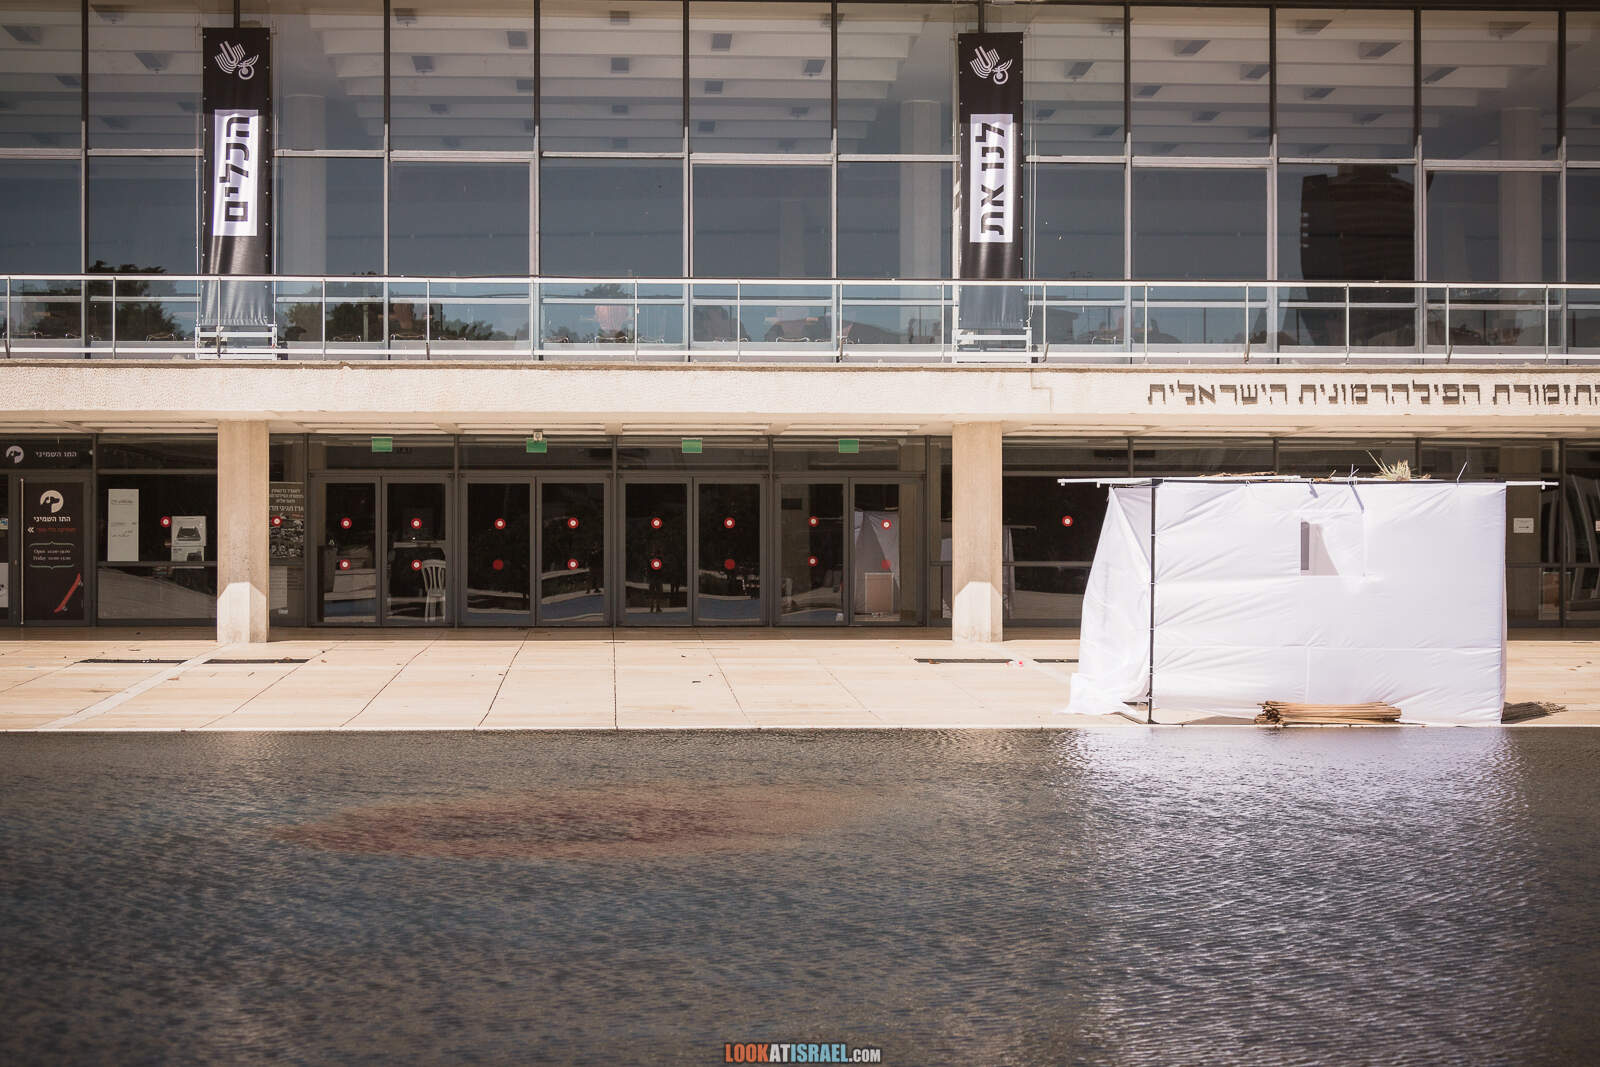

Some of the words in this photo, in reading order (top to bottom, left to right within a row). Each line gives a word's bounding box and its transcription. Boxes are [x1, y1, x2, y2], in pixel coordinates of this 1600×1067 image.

[219, 116, 250, 222] הכלים
[975, 122, 1005, 172] לנו
[981, 184, 1005, 236] את
[1148, 379, 1288, 405] הישראלית
[1299, 379, 1481, 405] הפילהרמונית
